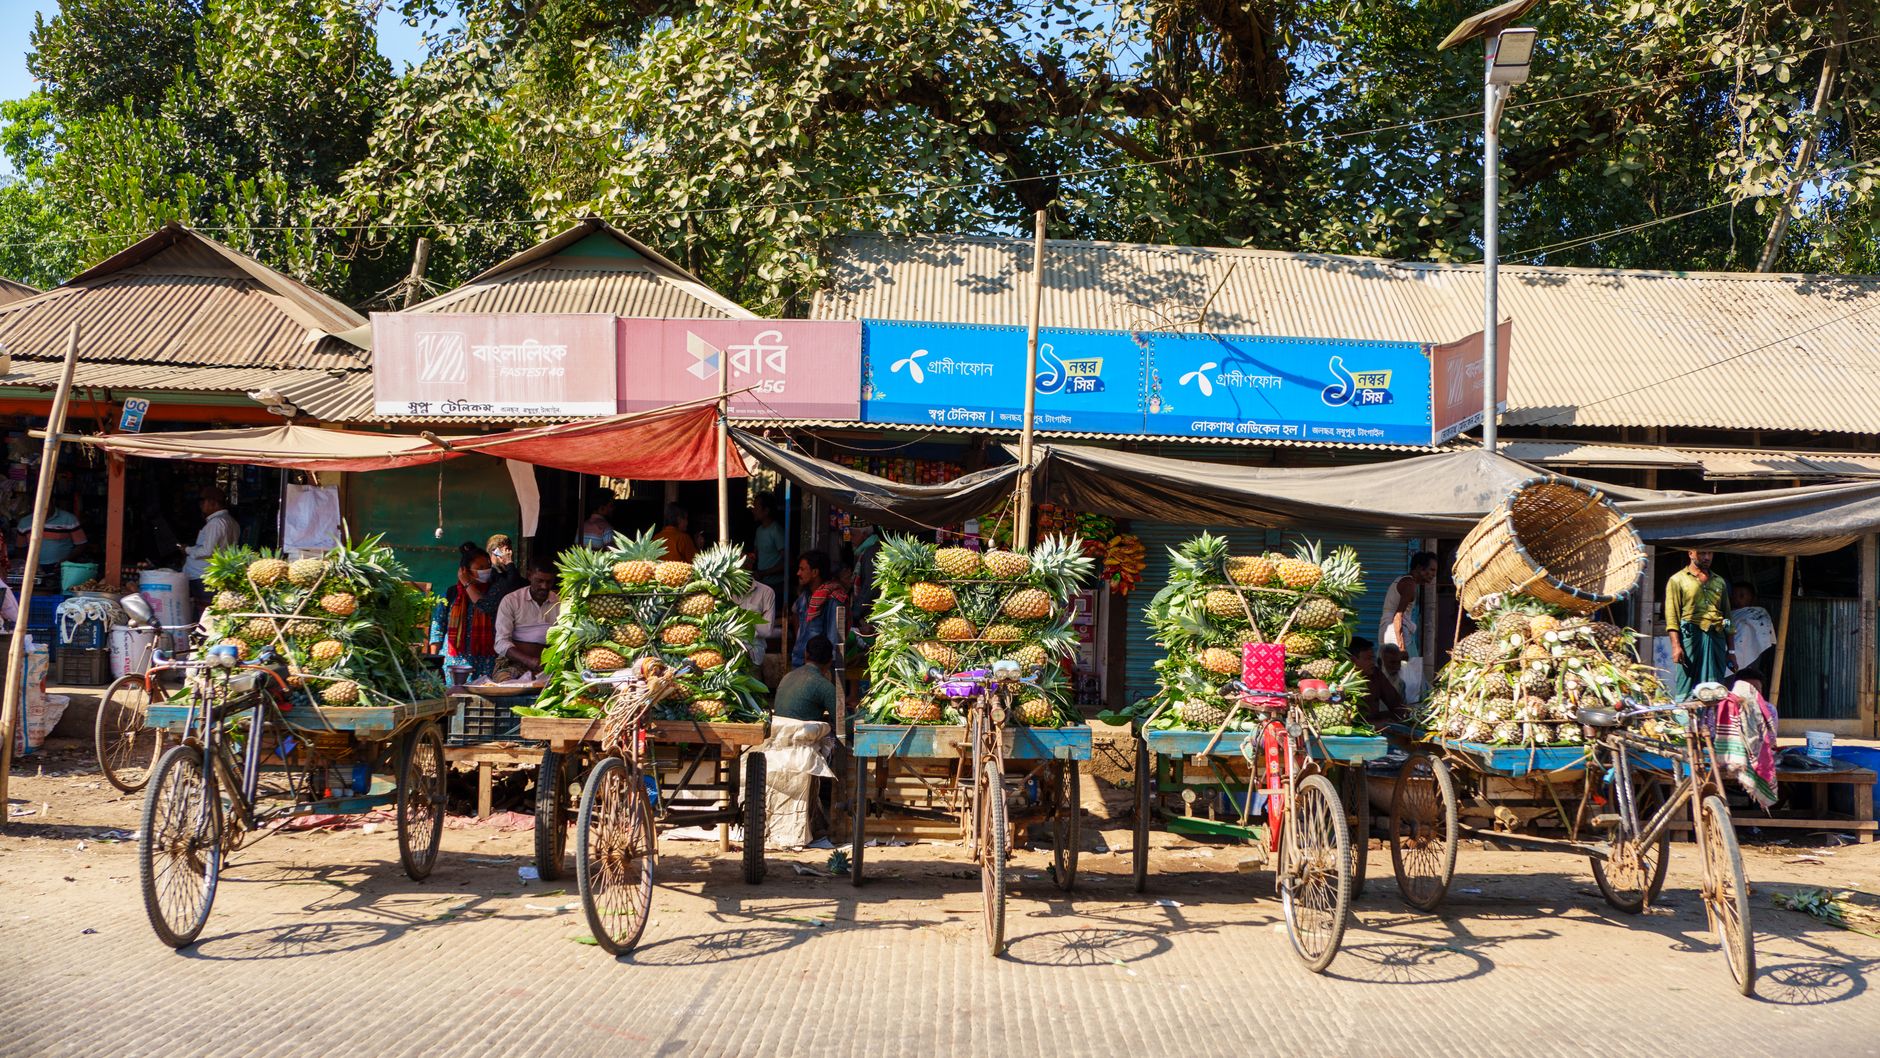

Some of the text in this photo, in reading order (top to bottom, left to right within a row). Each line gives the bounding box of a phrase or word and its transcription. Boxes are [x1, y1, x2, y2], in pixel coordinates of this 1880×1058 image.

[471, 338, 568, 363] বাংলালিংক
[727, 329, 789, 378] রবি
[500, 367, 565, 377] FASTEST 4G
[927, 357, 994, 377] গ্রামীণফোন
[1069, 359, 1097, 374] নম্বর
[1073, 376, 1095, 392] সিম
[1215, 370, 1282, 389] গ্রামীণফোন
[1358, 371, 1386, 387] নম্বর
[1362, 389, 1384, 405] সিম
[928, 408, 946, 421] স্বপ্ন
[947, 407, 986, 422] টেলিকম
[1236, 420, 1280, 435] মেডিকেল
[1281, 424, 1298, 436] হল
